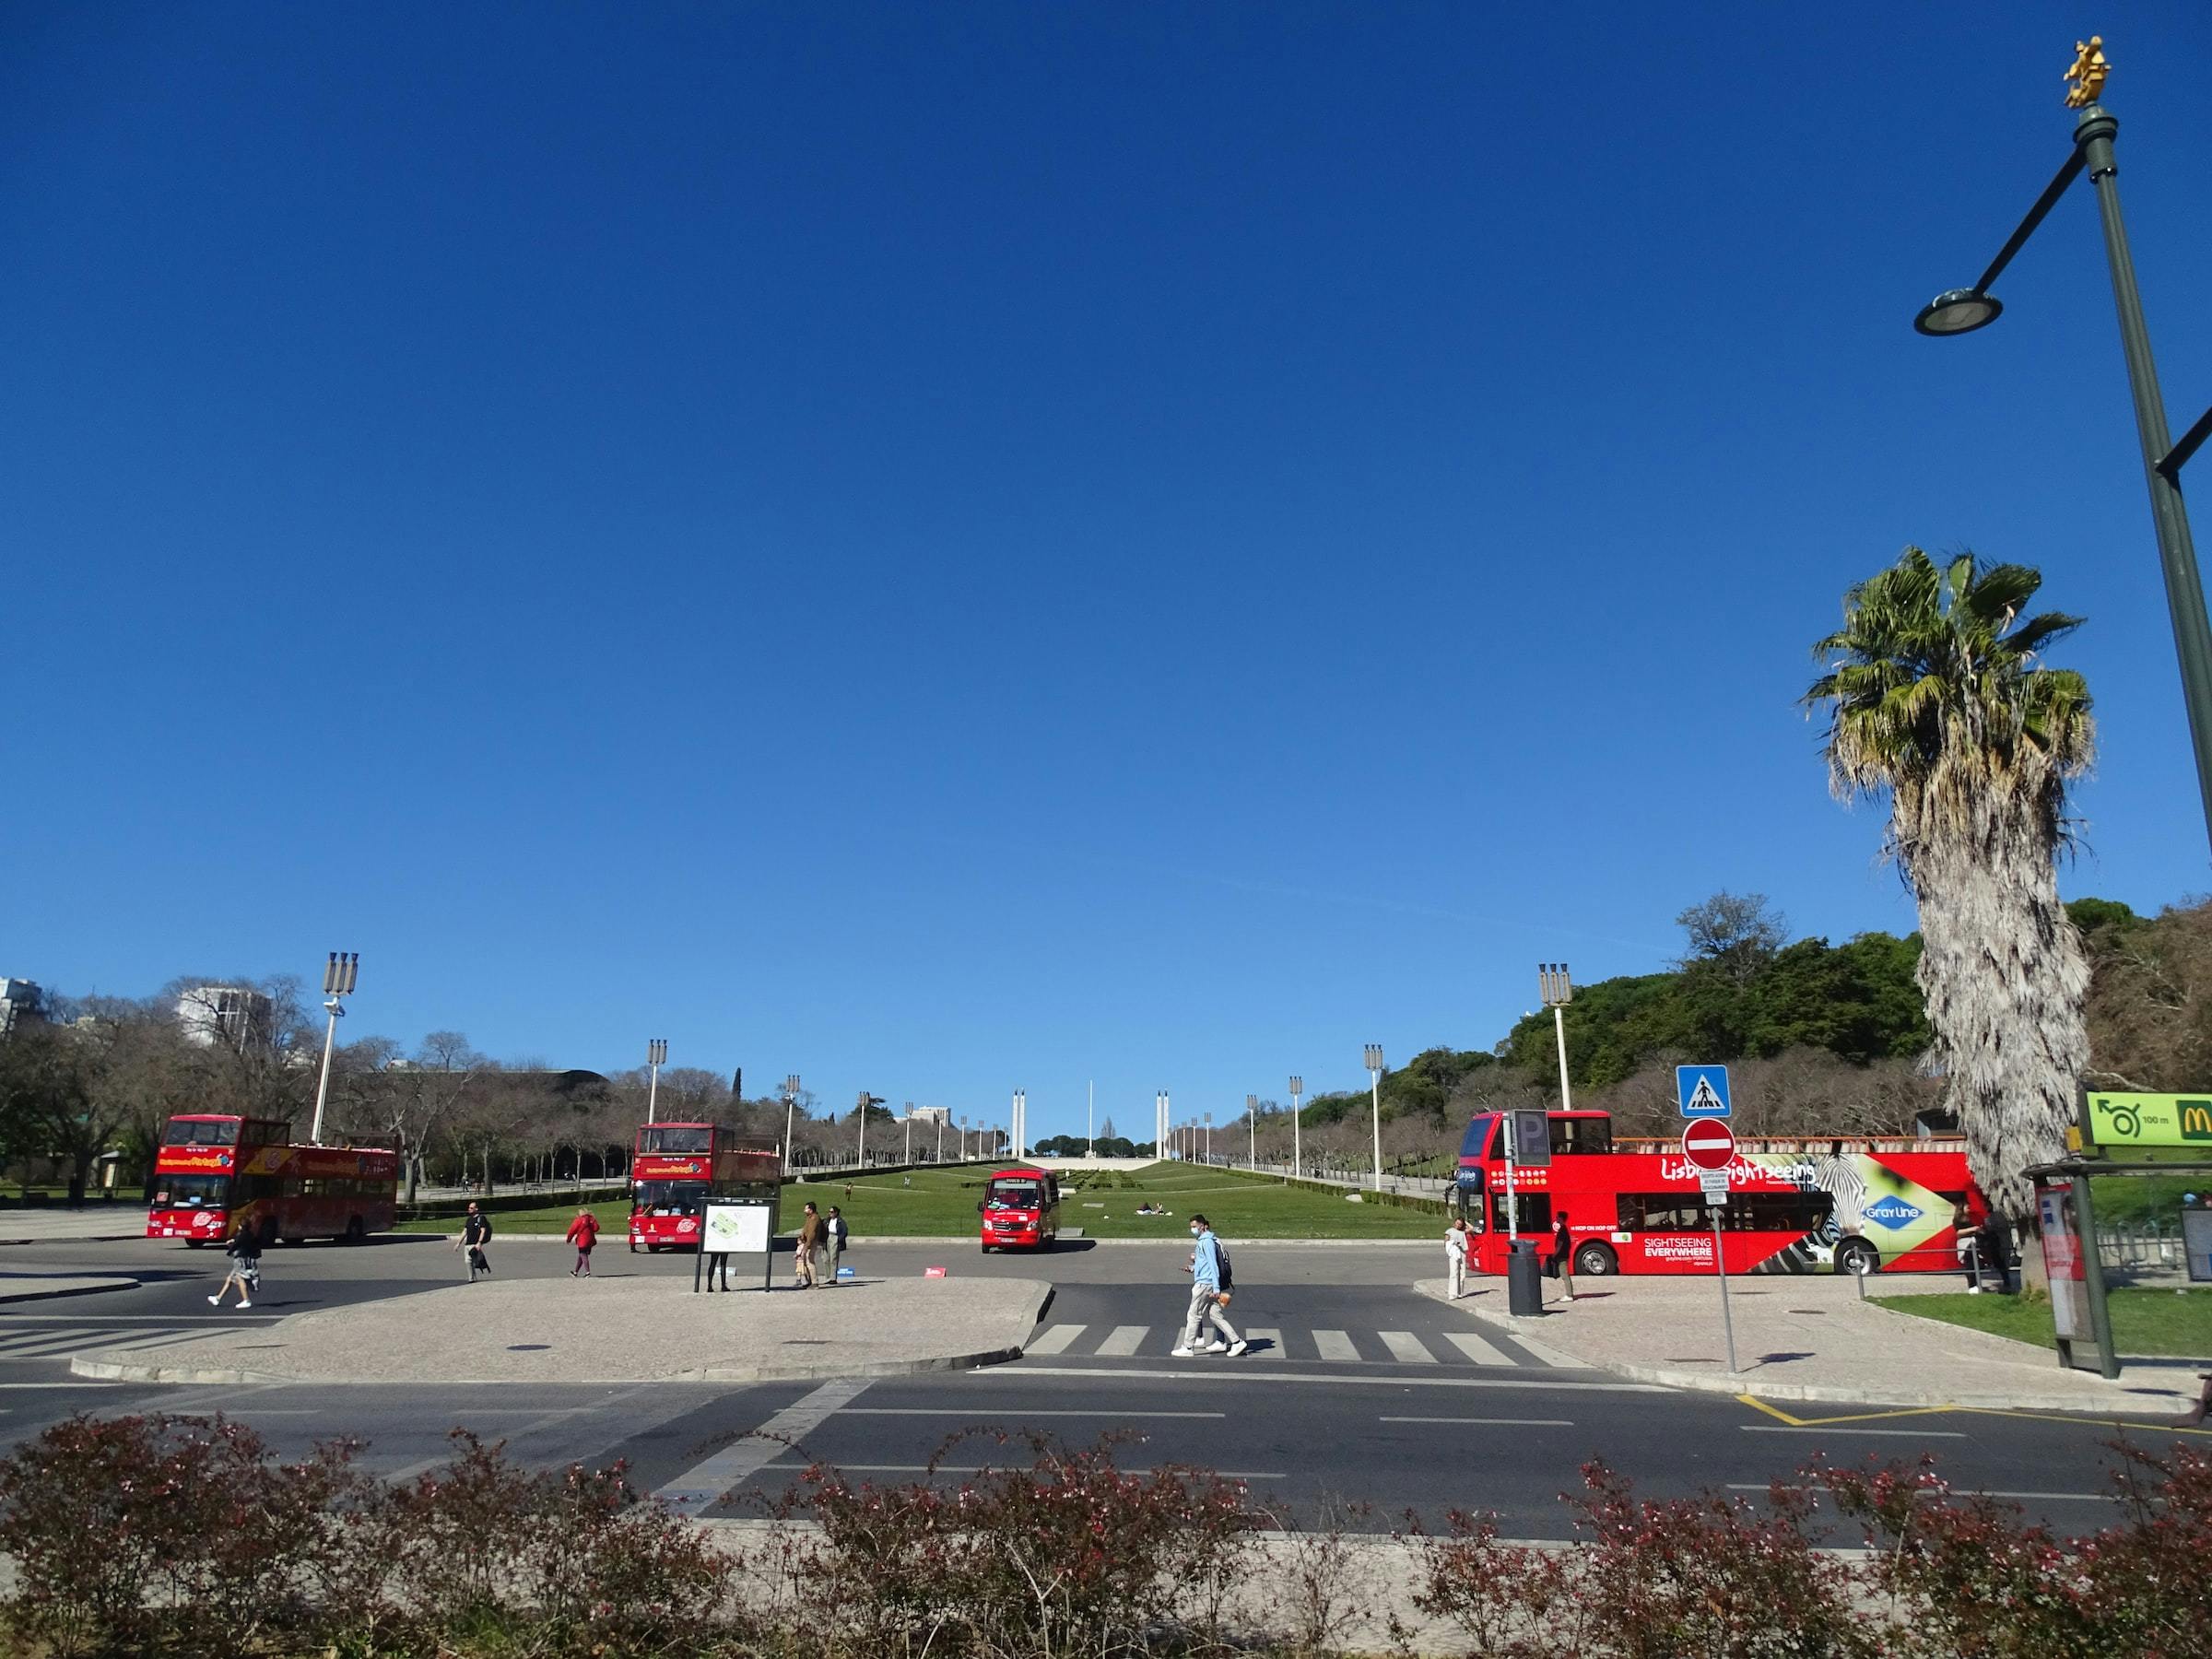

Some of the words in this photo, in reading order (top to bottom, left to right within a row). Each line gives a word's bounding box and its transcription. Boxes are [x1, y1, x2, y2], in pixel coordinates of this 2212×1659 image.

[2142, 1116, 2159, 1124] 100
[1519, 1113, 1544, 1153] P
[1644, 1238, 1712, 1248] SIGHTSEEING
[1645, 1247, 1712, 1257] EVERYWHERE
